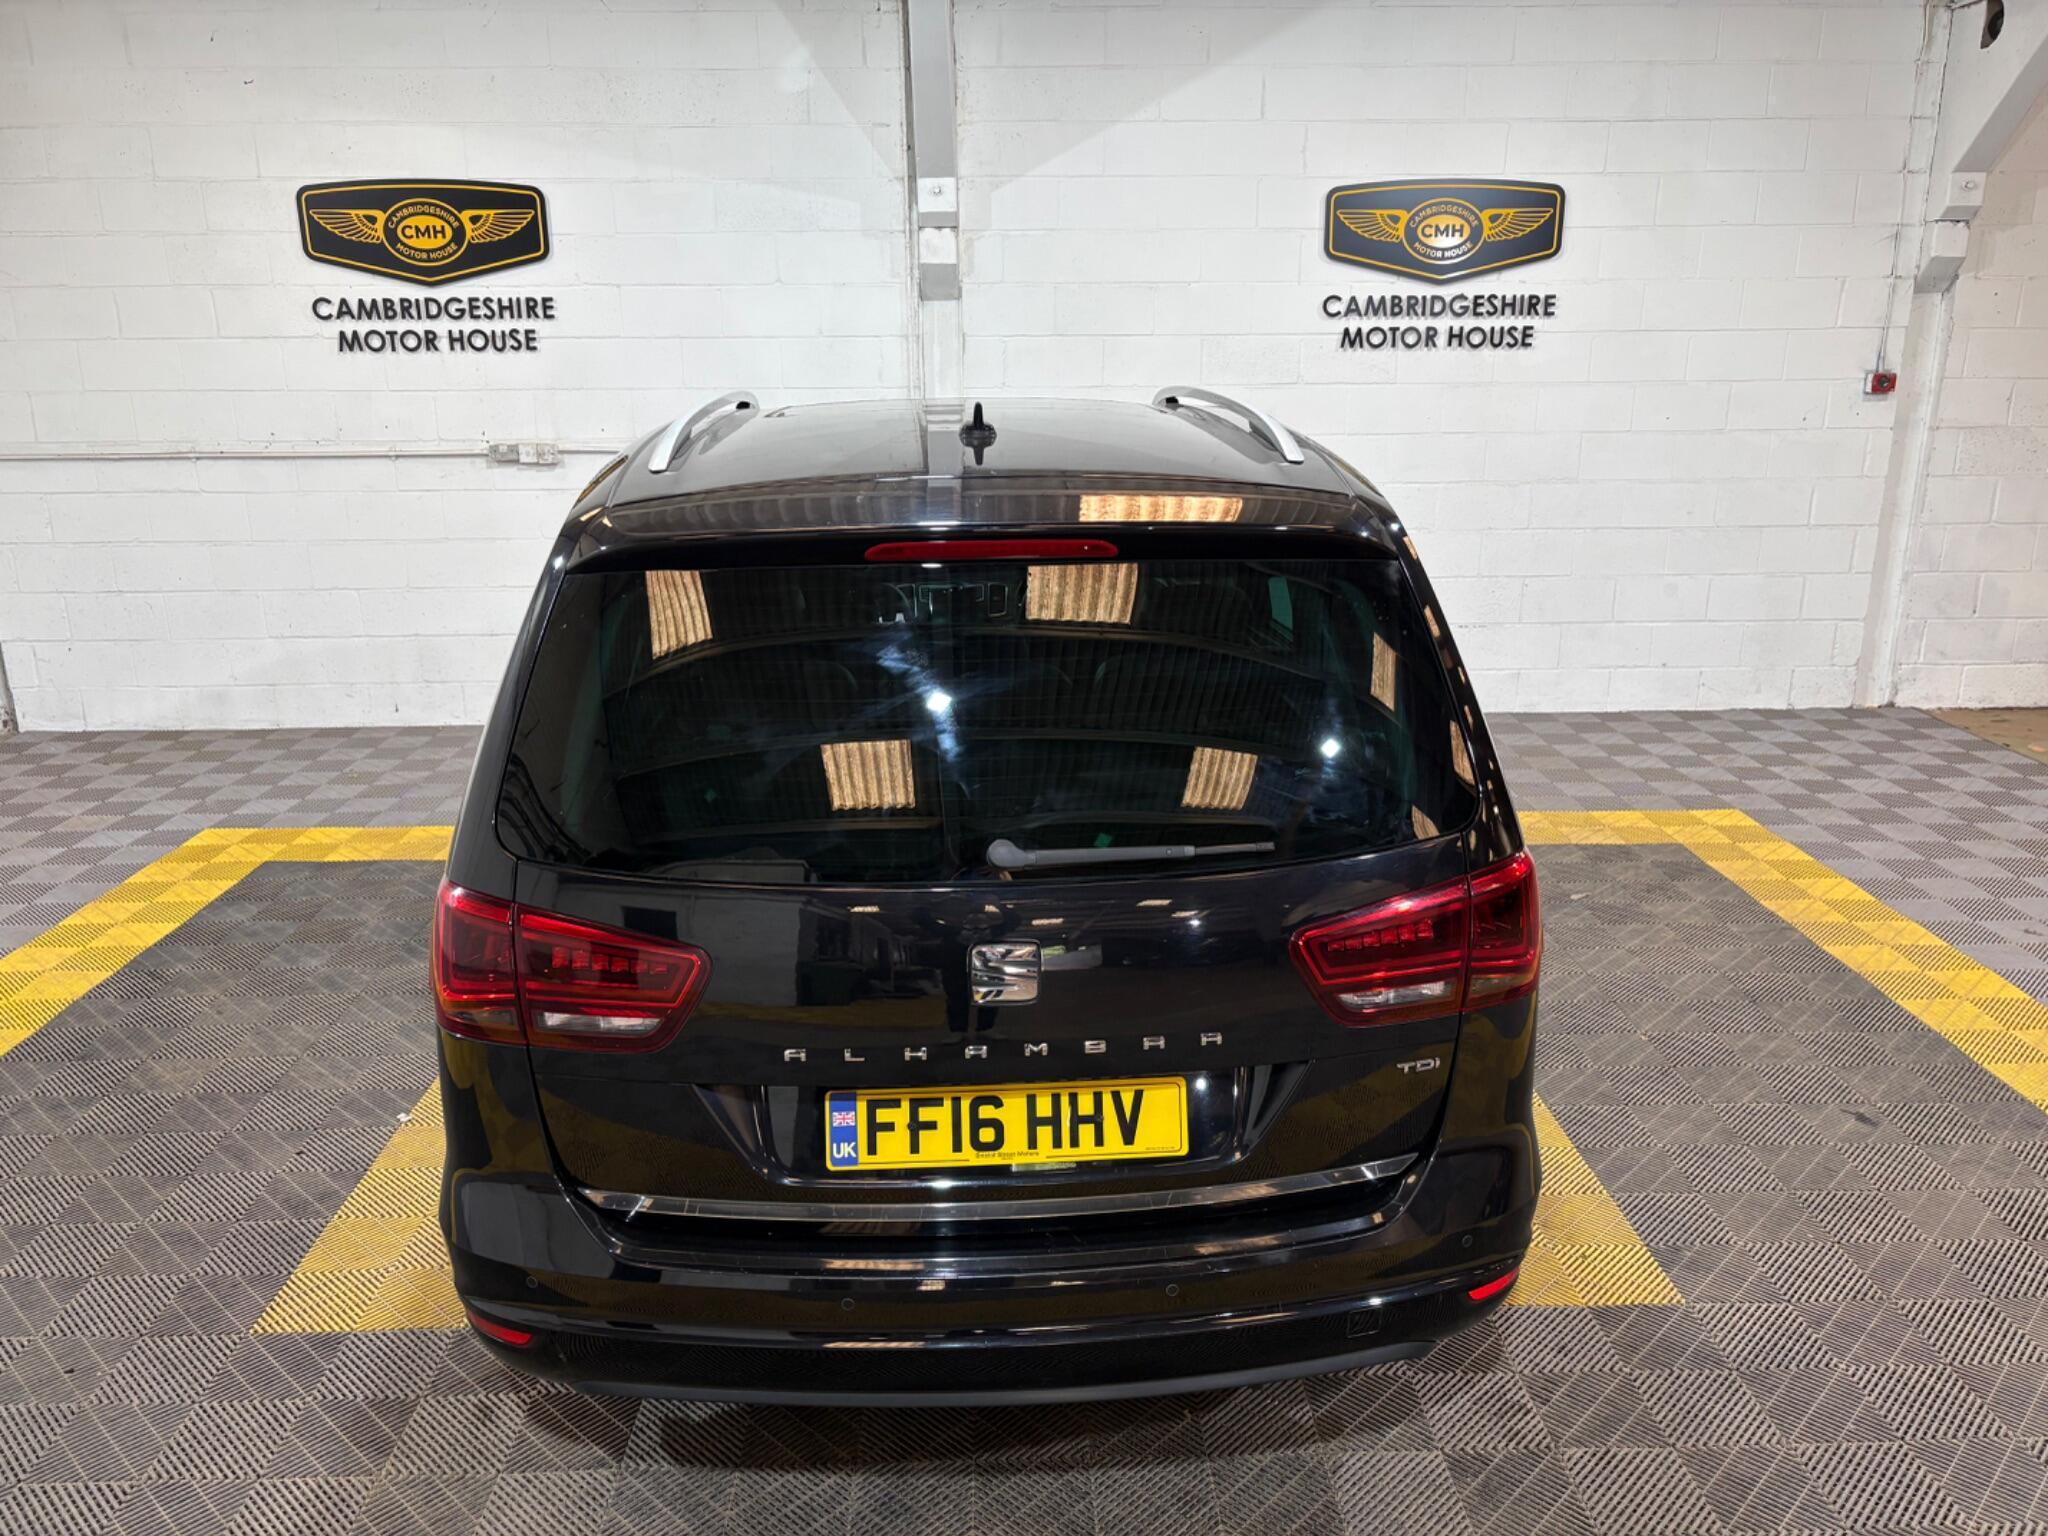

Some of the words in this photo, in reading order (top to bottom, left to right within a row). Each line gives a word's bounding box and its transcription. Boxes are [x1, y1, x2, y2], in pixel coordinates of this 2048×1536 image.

[388, 204, 461, 229] CAMBRIDGESHIRE
[1409, 204, 1480, 228] CAMBRIDGESHIRE
[400, 224, 447, 239] CMH
[1420, 223, 1464, 238] CMH
[395, 241, 429, 260] MOTOR
[429, 243, 458, 259] HOUSE
[1413, 240, 1443, 258] MOTOR
[1443, 240, 1473, 258] HOUSE
[312, 296, 556, 321] CAMBRIDGESHIRE
[1322, 293, 1557, 318] CAMBRIDGESHIRE
[338, 328, 440, 353] MOTOR
[448, 328, 538, 351] HOUSE
[1340, 325, 1438, 349] MOTOR
[1447, 325, 1535, 348] HOUSE
[783, 1031, 1223, 1062] ALHAMBRA
[1396, 1057, 1441, 1074] TDI
[866, 1095, 1005, 1156] FF16
[1026, 1089, 1144, 1150] HHV
[832, 1141, 857, 1159] UK
